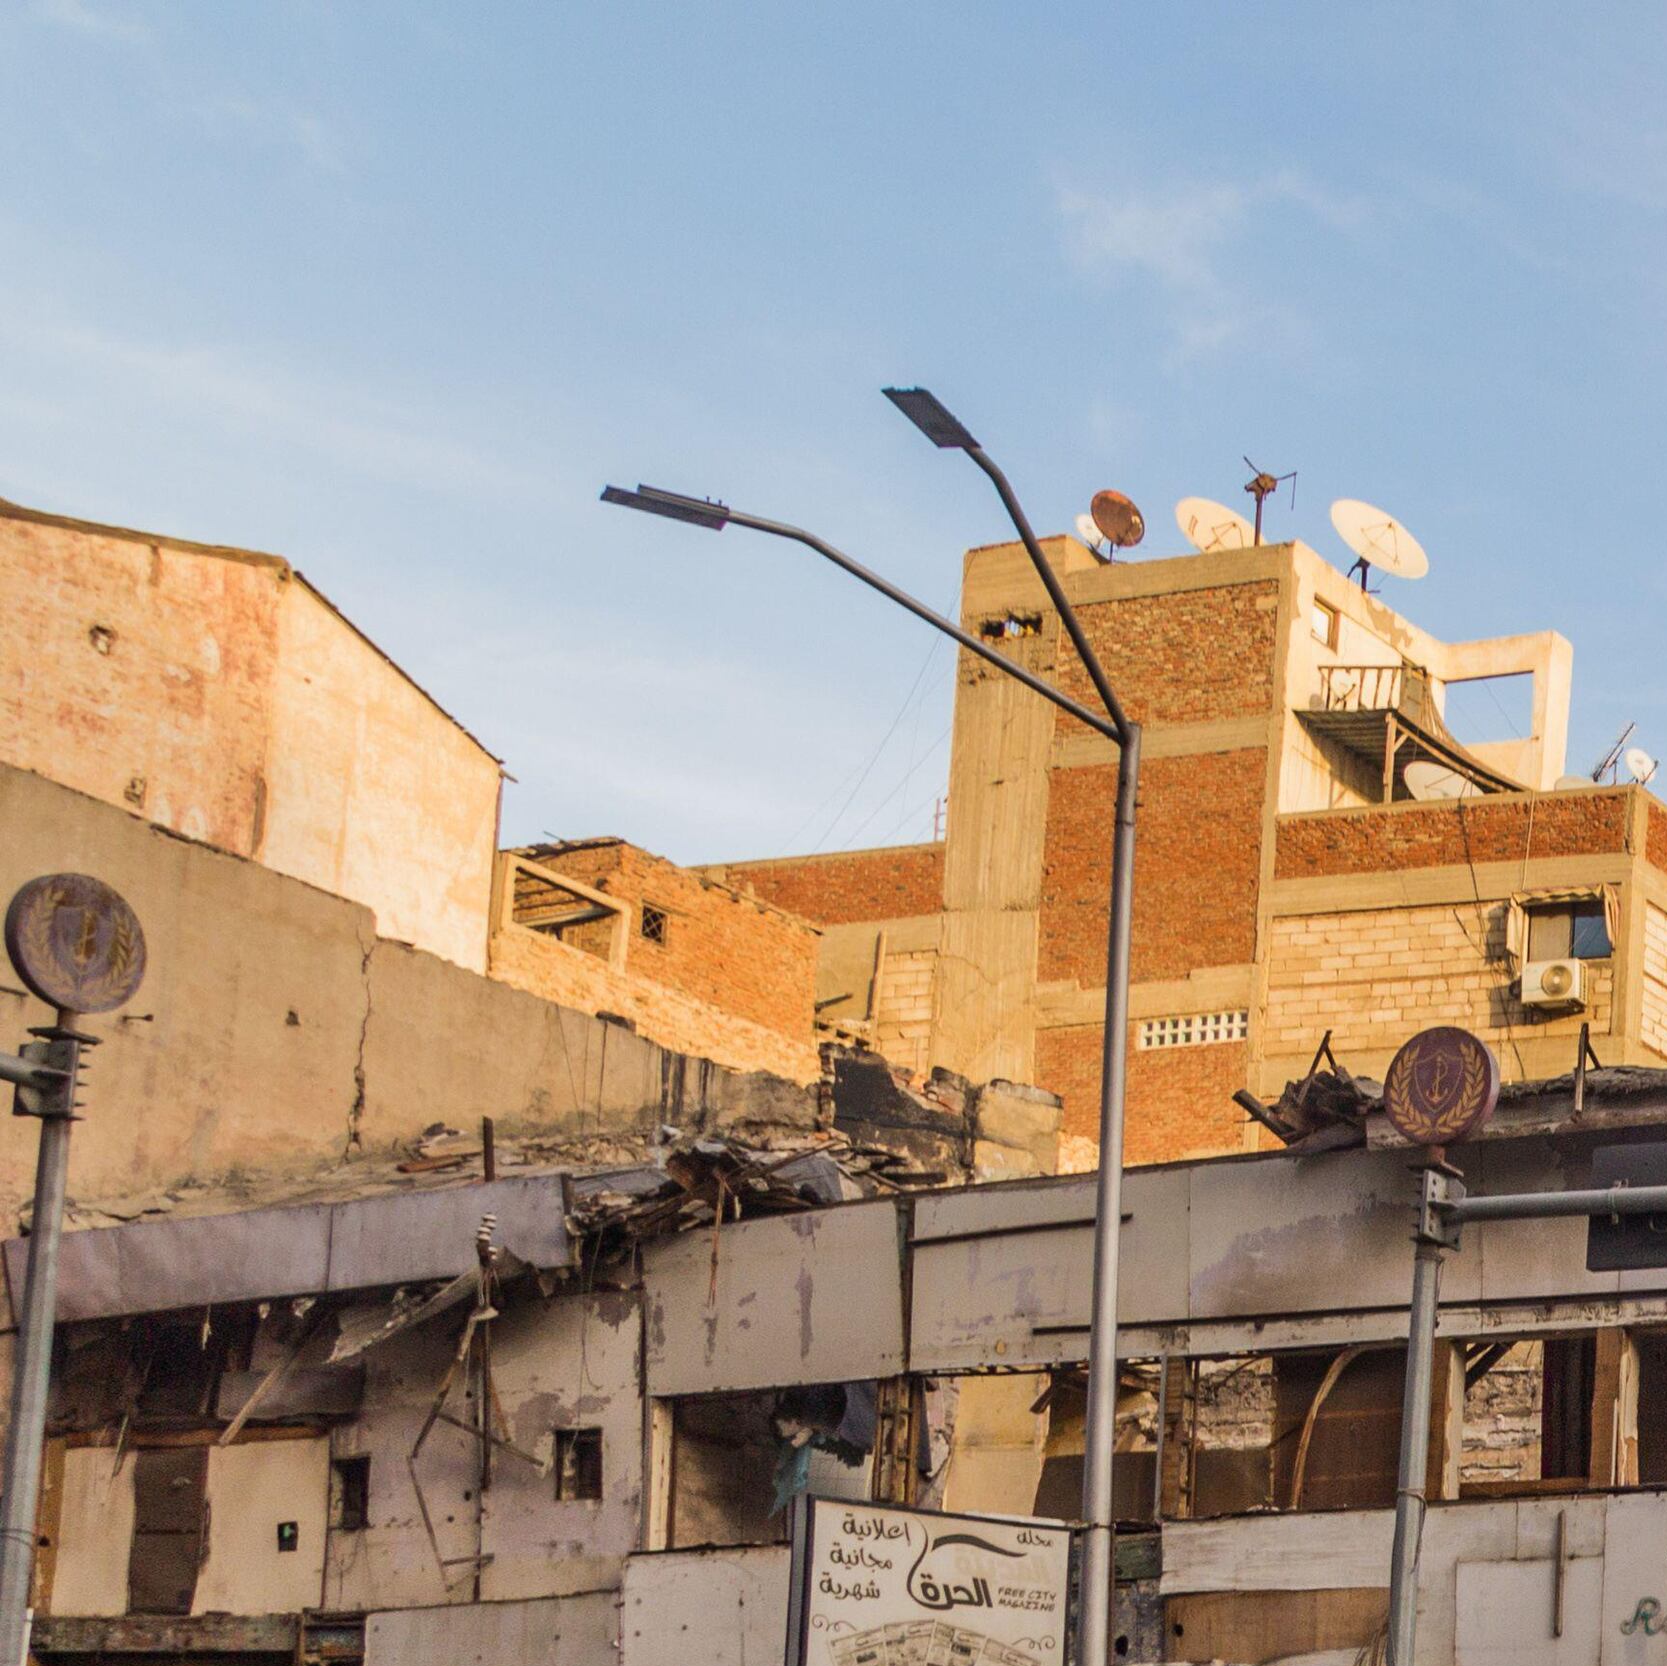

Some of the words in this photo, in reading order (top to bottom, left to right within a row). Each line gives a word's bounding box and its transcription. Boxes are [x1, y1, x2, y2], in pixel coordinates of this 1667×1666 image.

[830, 1543, 893, 1573] مجانية
[819, 1572, 881, 1600] شهرية
[908, 1573, 993, 1610] الحرة
[998, 1587, 1026, 1600] FREE
[1028, 1589, 1056, 1602] CITY
[998, 1600, 1055, 1613] MAGAZINE
